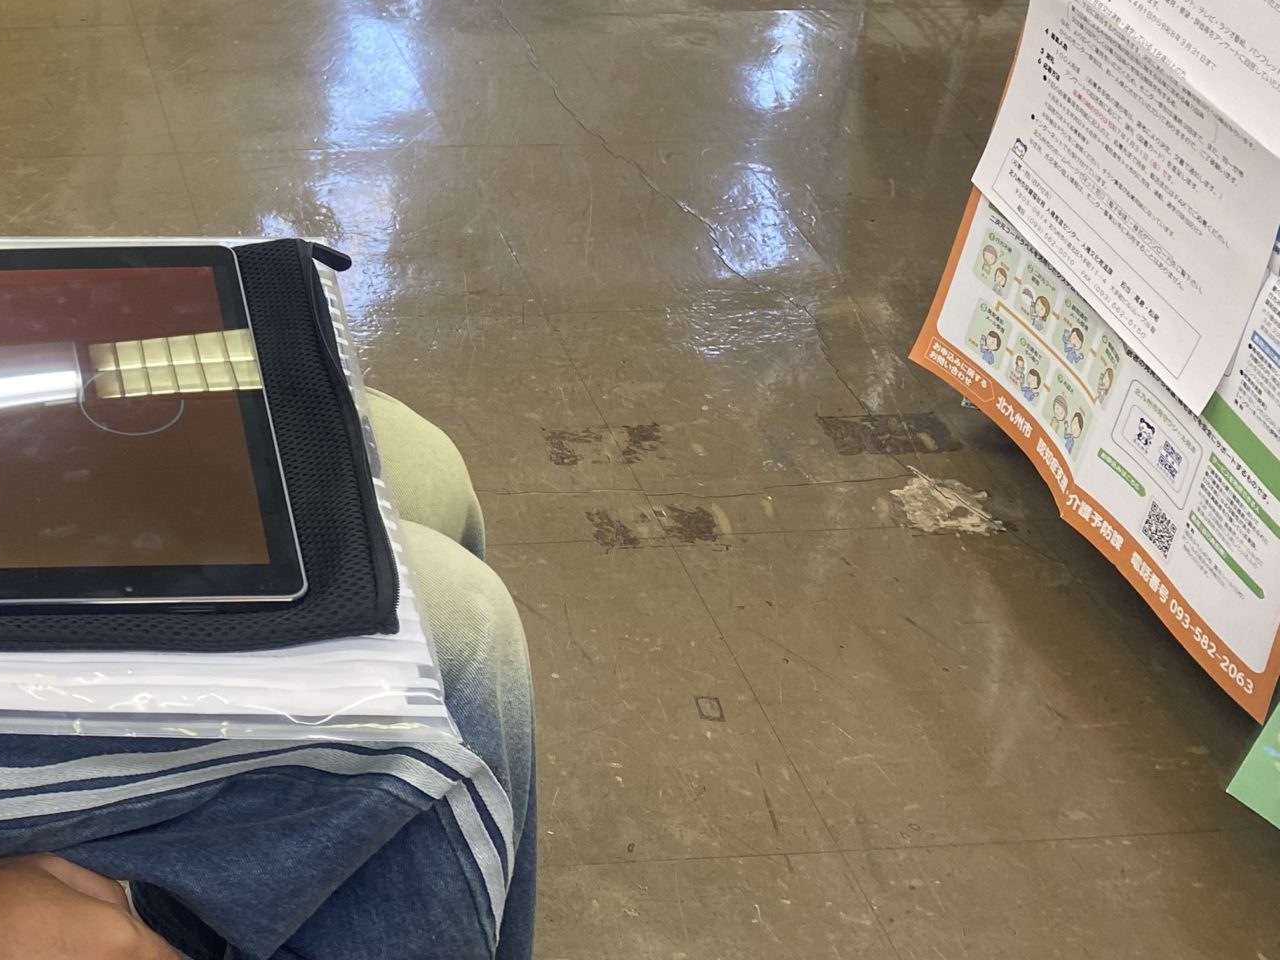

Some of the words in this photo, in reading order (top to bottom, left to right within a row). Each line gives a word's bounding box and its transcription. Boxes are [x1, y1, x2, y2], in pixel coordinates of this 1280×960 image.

[928, 350, 972, 386] お問い合わせ
[931, 341, 988, 389] お申込みに関する
[996, 396, 1033, 438] 北九州市
[1130, 550, 1169, 604] 電話番号
[1169, 599, 1254, 695] 093-582-2063
